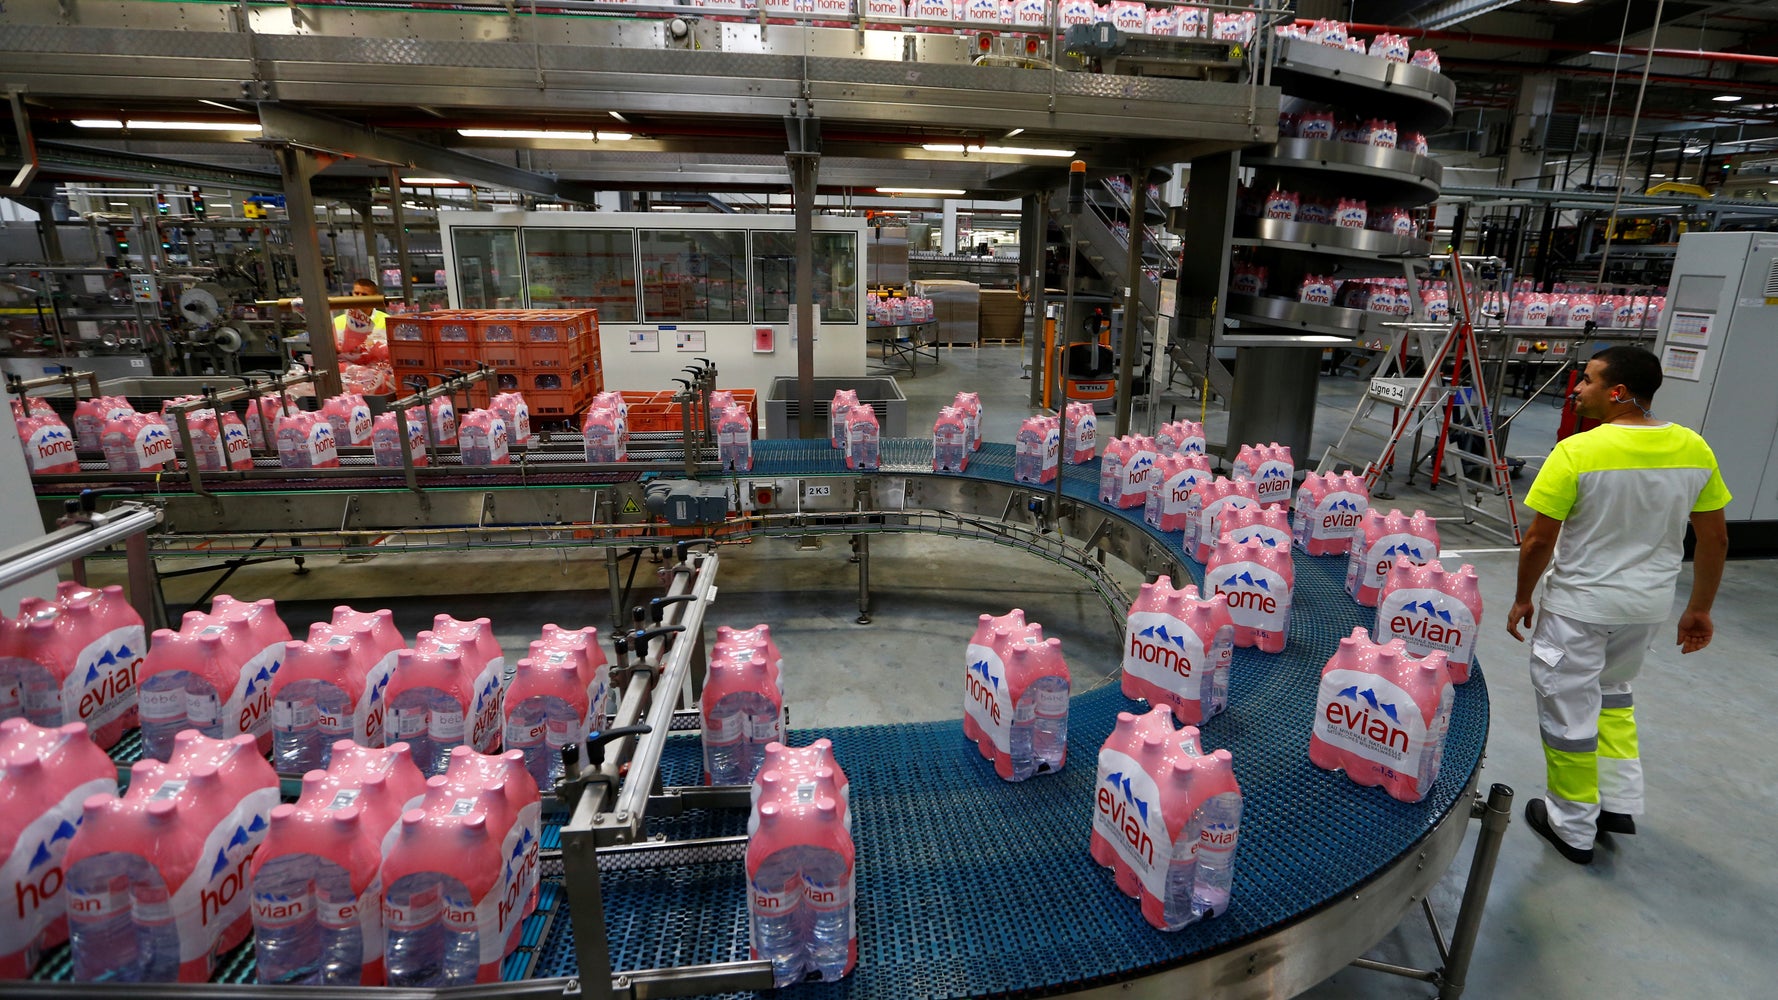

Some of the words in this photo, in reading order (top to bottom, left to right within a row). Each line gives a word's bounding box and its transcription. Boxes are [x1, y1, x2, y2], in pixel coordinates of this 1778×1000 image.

[817, 0, 846, 10] home
[869, 2, 897, 13] home
[920, 4, 948, 16] home
[970, 7, 997, 19] home
[1020, 10, 1045, 22] home
[1064, 13, 1090, 26] home
[1117, 16, 1143, 28] home
[1152, 26, 1170, 34] hom
[1302, 130, 1328, 140] home
[1374, 138, 1395, 148] home
[1268, 209, 1292, 220] home
[1341, 218, 1364, 228] home
[1304, 293, 1329, 304] home
[1370, 303, 1392, 312] home
[1527, 310, 1547, 320] home
[1572, 312, 1591, 321] home
[1370, 382, 1391, 395] Ligne
[1392, 387, 1403, 398] 3-4
[354, 418, 372, 436] evian
[410, 434, 424, 450] ome
[494, 432, 508, 449] home
[1080, 428, 1096, 442] evian
[38, 438, 73, 459] home
[142, 438, 172, 458] home
[228, 438, 249, 453] ome
[314, 436, 335, 454] home
[1047, 444, 1058, 460] hom
[1129, 468, 1150, 484] hom
[1258, 478, 1290, 494] evian
[1172, 488, 1191, 503] ho
[1390, 615, 1462, 646] evian
[1130, 632, 1191, 678] home
[966, 665, 1000, 726] home
[240, 686, 271, 732] evi
[1326, 702, 1410, 753] evian
[1098, 787, 1154, 866] evian
[1200, 829, 1238, 845] evian
[16, 866, 64, 920] ho
[498, 840, 538, 934] home
